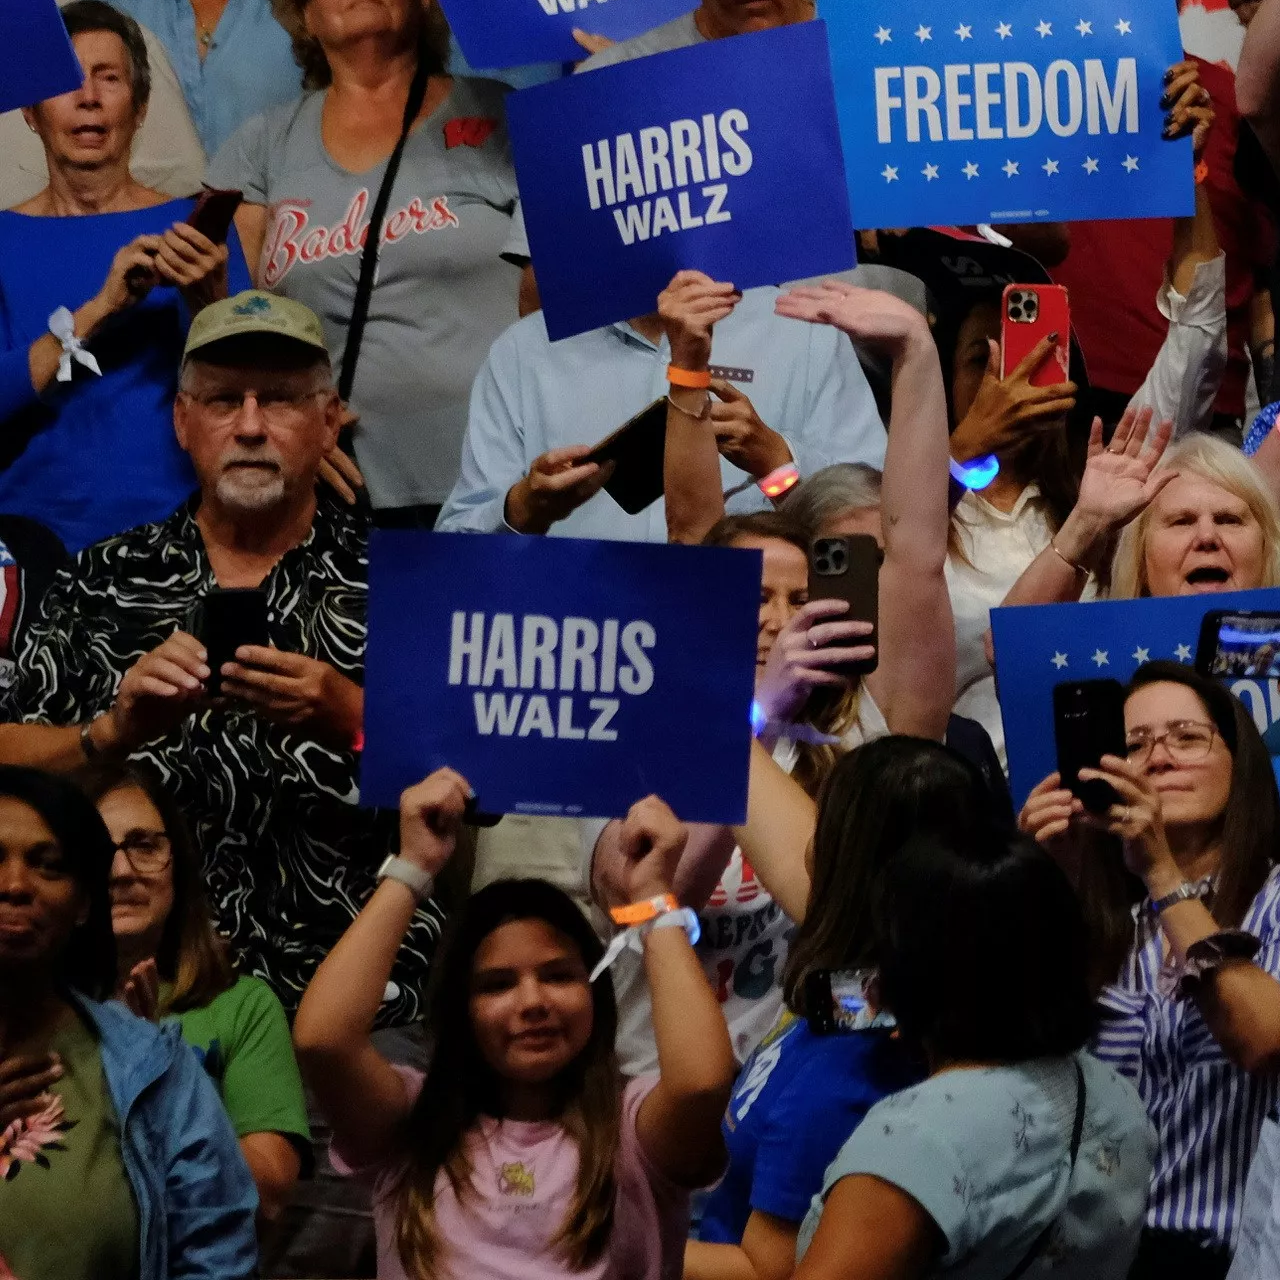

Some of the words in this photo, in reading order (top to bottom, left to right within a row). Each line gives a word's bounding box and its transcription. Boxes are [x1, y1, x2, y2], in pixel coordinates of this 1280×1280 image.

[874, 58, 1138, 143] FREEDOM
[582, 109, 752, 209] HARRIS
[614, 185, 731, 245] WALZ
[448, 611, 656, 695] HARRIS
[474, 693, 619, 741] WALZ
